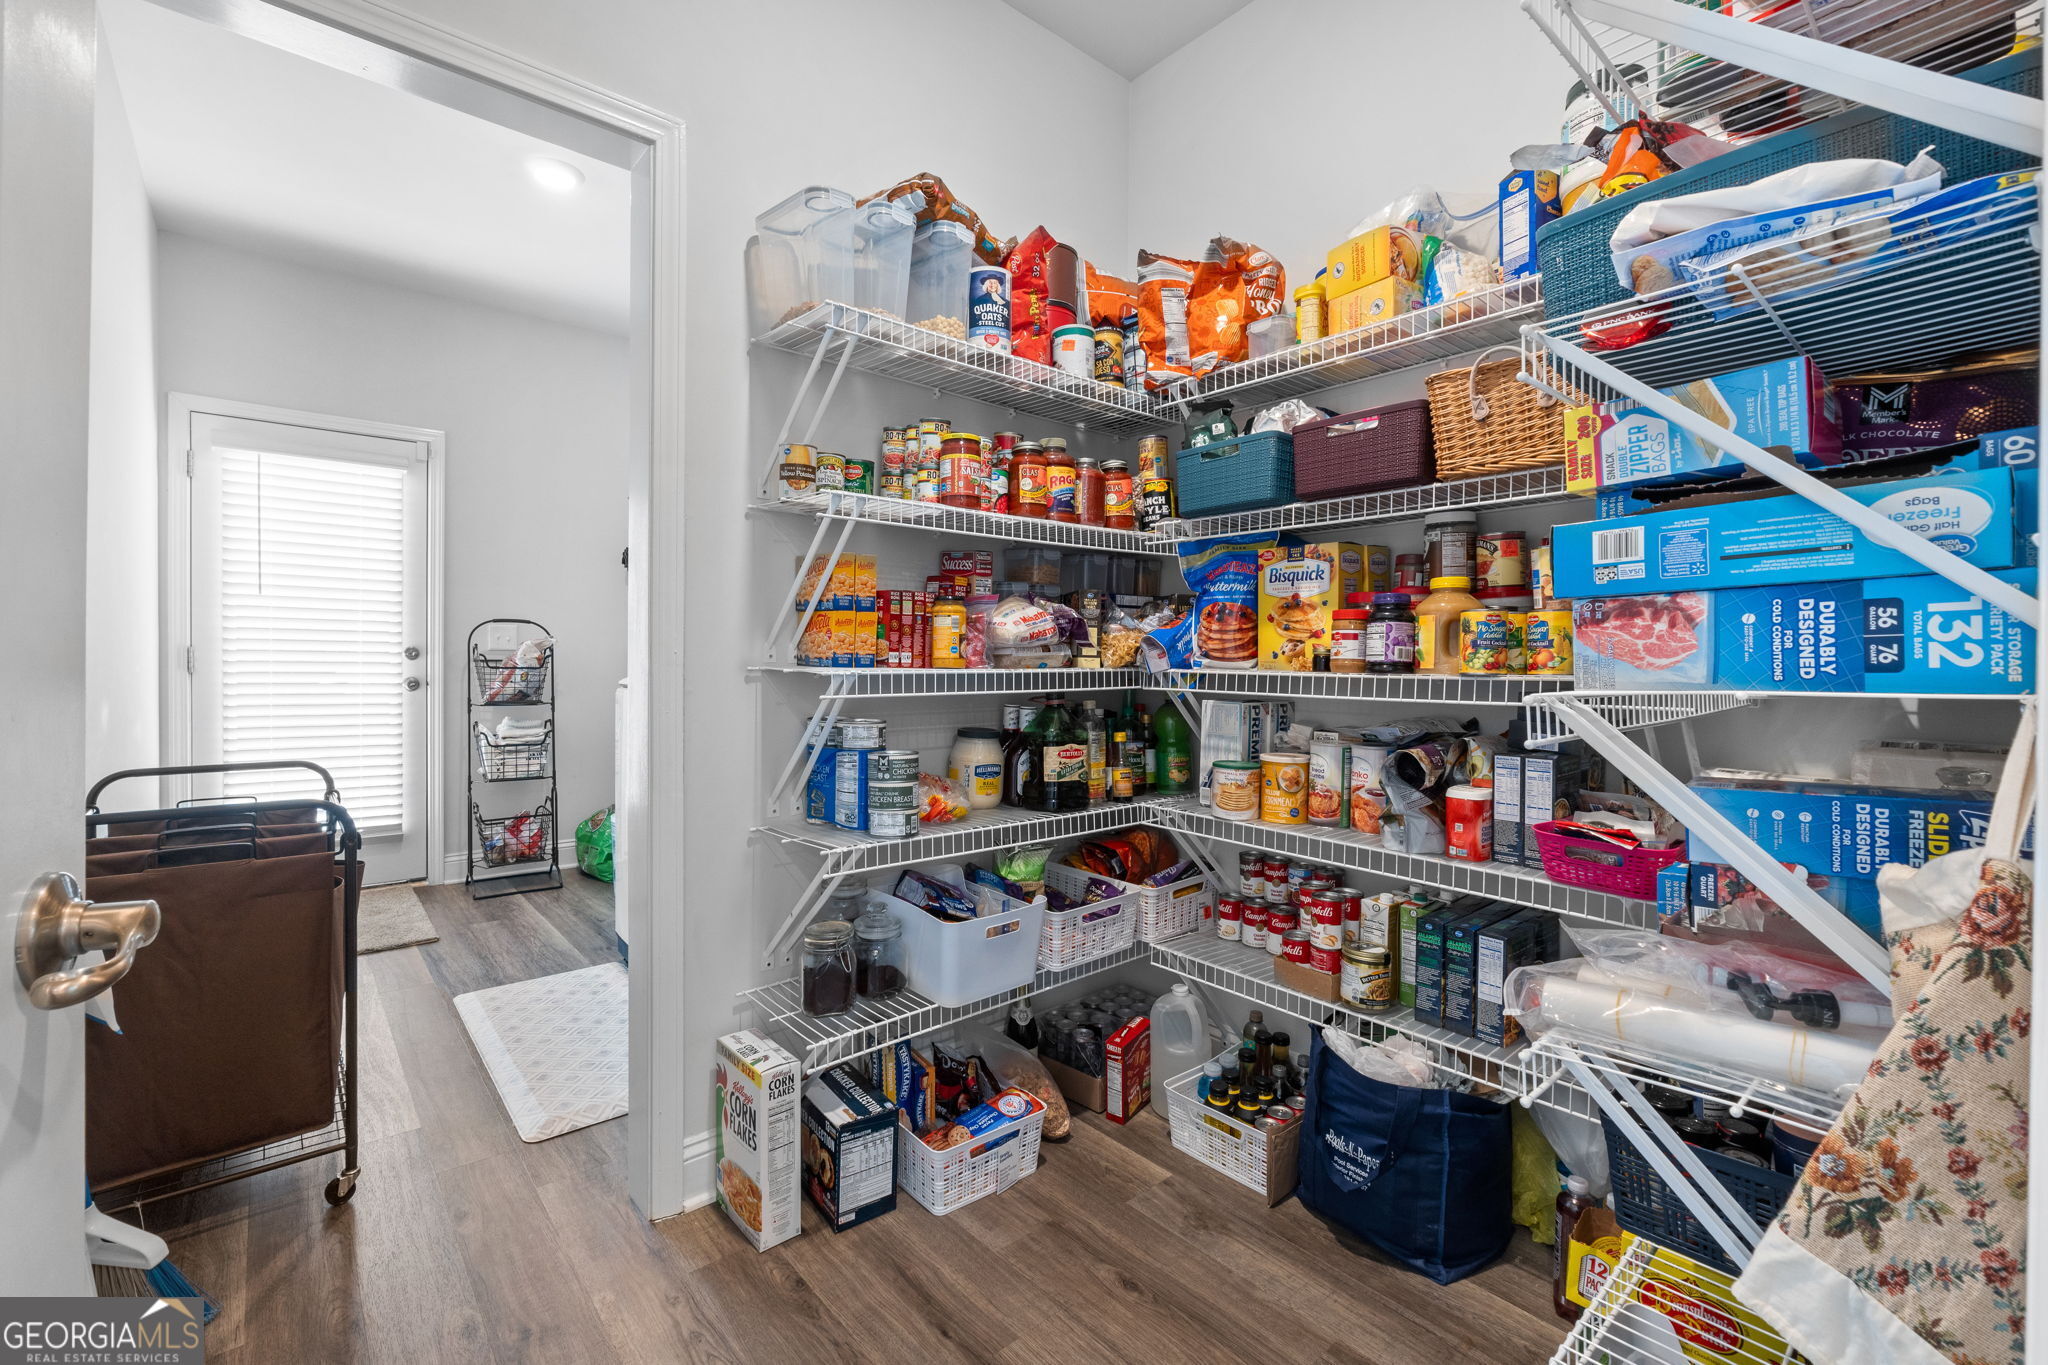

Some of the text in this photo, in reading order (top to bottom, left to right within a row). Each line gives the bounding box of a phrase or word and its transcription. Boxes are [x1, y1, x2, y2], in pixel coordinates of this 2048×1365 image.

[1033, 265, 1041, 277] 32
[1245, 283, 1276, 303] Honey
[974, 303, 1009, 317] QUAKER
[981, 312, 1003, 322] OATS
[1603, 309, 1656, 326] PNC BANK
[1746, 396, 1756, 434] BPA FREE
[1862, 409, 1907, 419] Member's
[1871, 416, 1895, 425] Mark
[1576, 415, 1591, 440] 200
[1860, 429, 1942, 439] CHOCOLATE
[1628, 423, 1650, 477] ZIPPER
[1649, 432, 1667, 474] BAGS
[1985, 438, 1995, 457] BAGS
[2003, 434, 2037, 465] 60
[1567, 440, 1593, 482] FAMILY SIZE
[1605, 452, 1616, 481] SNACK
[1618, 444, 1629, 479] DOUBLE
[817, 477, 842, 485] SPINACH
[1905, 496, 1940, 507] Bags
[1933, 521, 1961, 531] Half
[942, 555, 973, 571] Success
[1628, 567, 1644, 575] USA
[1203, 578, 1257, 592] Buttermilk
[1268, 564, 1325, 587] Bisquick
[806, 613, 831, 633] veeta
[1877, 606, 1898, 628] 56
[1477, 624, 1488, 633] No
[1529, 625, 1548, 633] Sugar
[1783, 629, 1793, 649] FOR
[1798, 598, 1816, 680] DESIGNED
[1818, 600, 1837, 676] DURABLY
[1913, 609, 1924, 660] TOTAL BAGS
[1926, 595, 1985, 669] 132
[1772, 599, 1784, 681] COLD CONDITIONS
[1870, 644, 1878, 665] QUART
[1877, 643, 1899, 664] 76
[1990, 643, 2005, 676] PACK
[2007, 627, 2023, 683] STORAGE
[1251, 704, 1261, 761] PREMI
[1059, 750, 1084, 758] BERTOLLI
[893, 767, 916, 776] CHICKEN
[1264, 788, 1280, 796] YELLOW
[1264, 796, 1295, 806] CORNMEAL
[1831, 800, 1841, 873] COLD CONDITIONS
[1842, 828, 1852, 846] FOR
[1855, 803, 1871, 874] DESIGNED
[1874, 807, 1890, 869] DURABL
[1908, 809, 1925, 869] FREEZE
[1927, 811, 1950, 860] SLID
[1707, 873, 1715, 902] FREEZER
[1361, 974, 1379, 984] BETTER
[743, 1044, 761, 1056] CORN
[720, 1044, 756, 1081] FAMILY SIZE
[899, 1046, 912, 1099] TASTYKAKE
[733, 1080, 754, 1105] Kellogg's
[768, 1073, 795, 1092] CORN
[768, 1084, 796, 1102] FLAKES
[830, 1067, 884, 1116] CRACKER COLLECTION
[730, 1090, 757, 1132] CORN
[729, 1112, 757, 1152] FLAKES
[1587, 1257, 1609, 1281] 12
[1585, 1276, 1605, 1293] PAC
[1649, 1283, 1735, 1338] Pennsylvania
